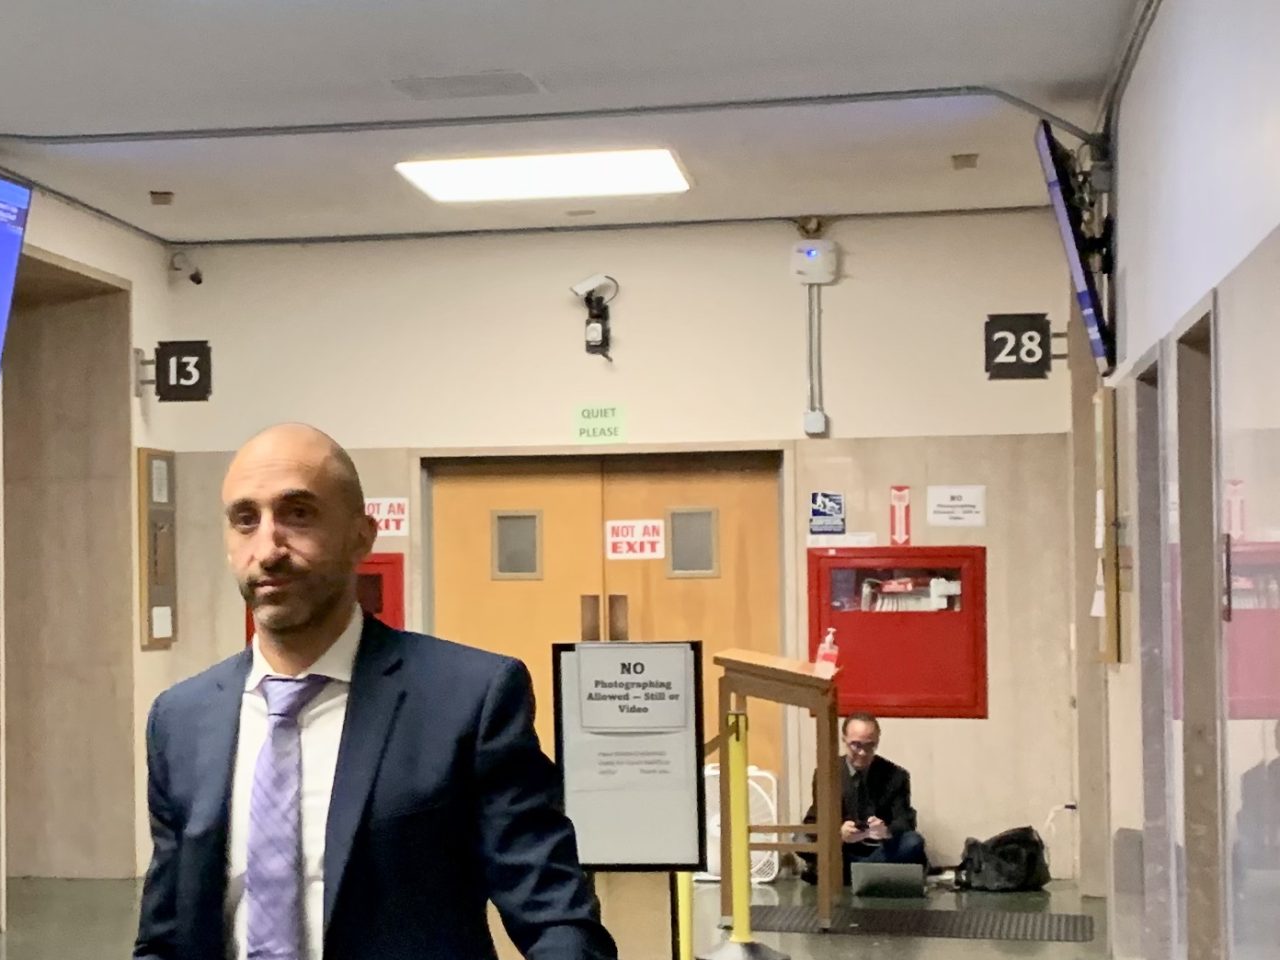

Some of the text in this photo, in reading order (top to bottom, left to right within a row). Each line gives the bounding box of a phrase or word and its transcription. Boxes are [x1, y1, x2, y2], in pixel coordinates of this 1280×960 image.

[993, 330, 1043, 363] 28
[168, 356, 200, 386] 13
[581, 408, 616, 419] QUIET
[579, 427, 619, 437] PLEASE
[364, 503, 405, 515] OT AN
[611, 525, 660, 538] NOT AN
[611, 541, 660, 554] EXIT
[620, 662, 646, 674] NO
[594, 680, 672, 690] Photographing
[587, 692, 630, 701] Allowed
[644, 692, 666, 701] Still
[618, 704, 649, 714] Video
